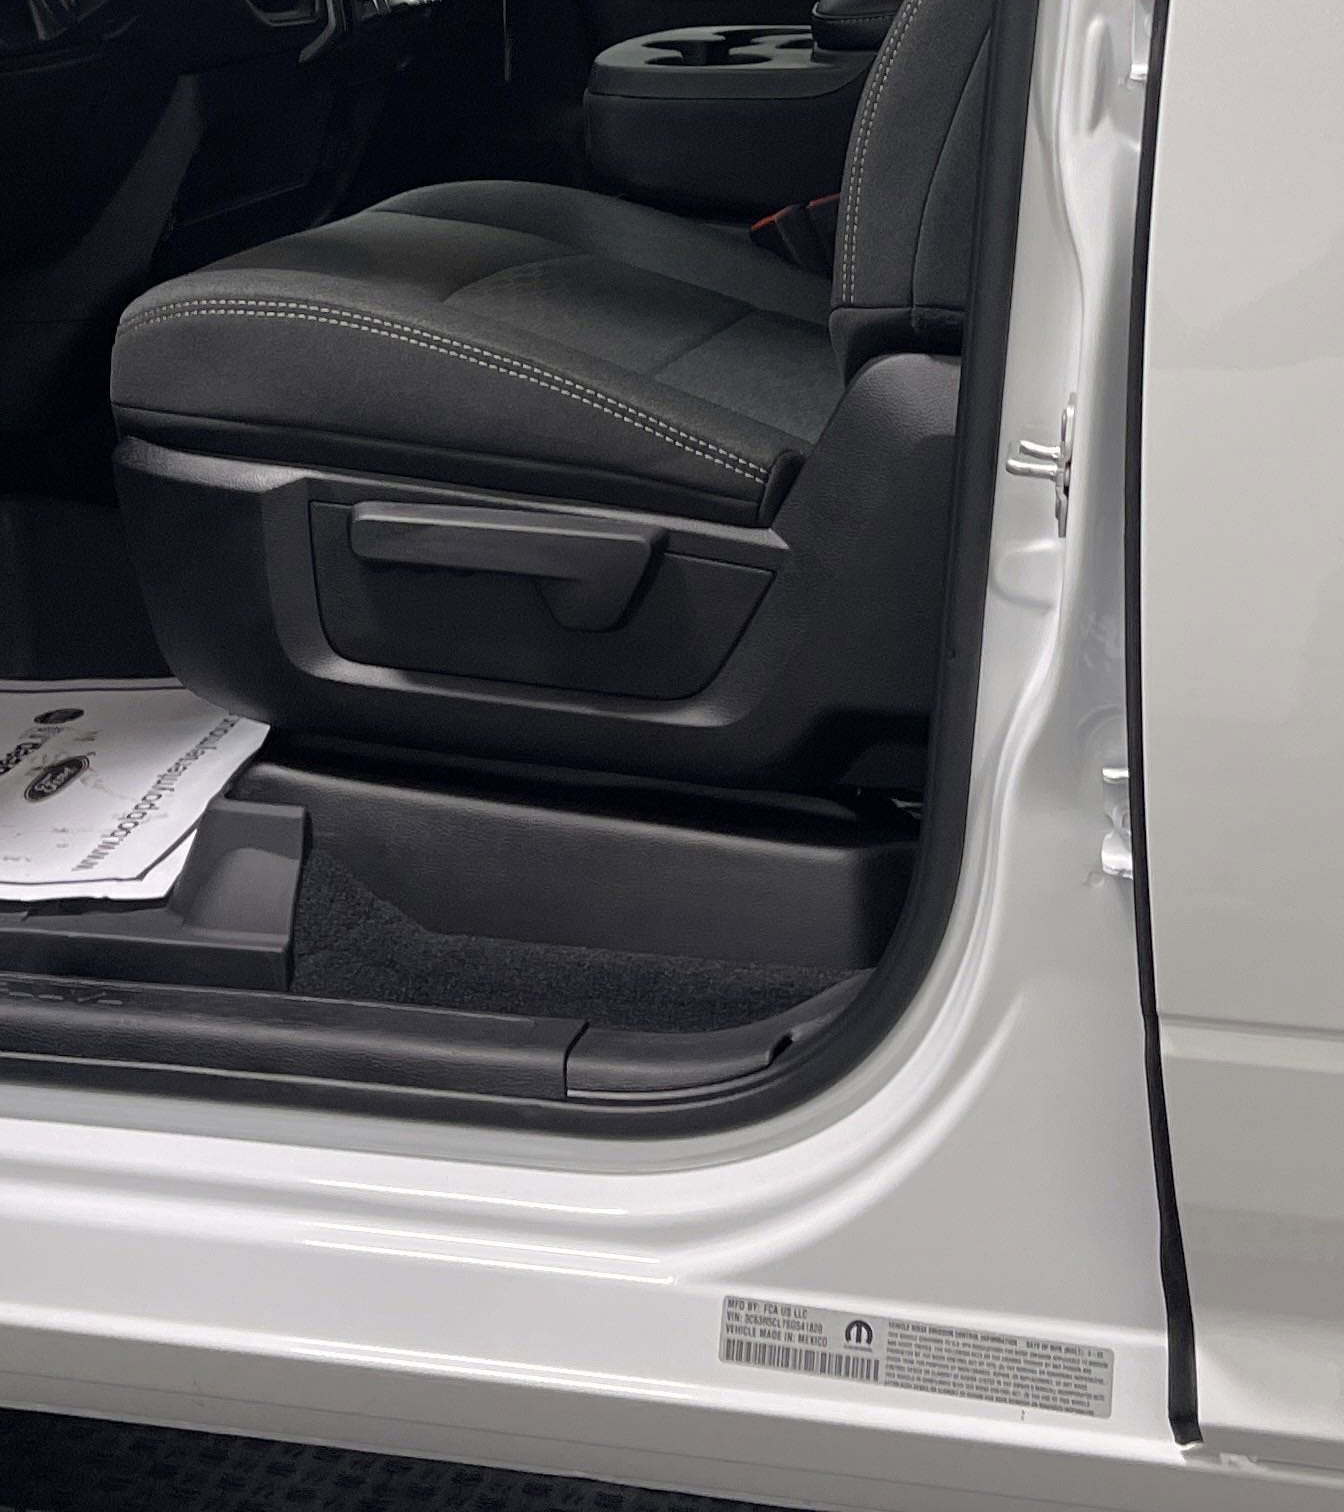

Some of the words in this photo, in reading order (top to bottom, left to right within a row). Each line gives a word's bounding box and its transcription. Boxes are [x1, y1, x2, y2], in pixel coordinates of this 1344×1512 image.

[763, 1302, 779, 1315] FCA
[781, 1305, 792, 1317] US
[793, 1306, 808, 1319] LLC
[726, 1321, 757, 1338] VEHICLE
[759, 1326, 782, 1341] MADE
[798, 1332, 829, 1348] MEXICO
